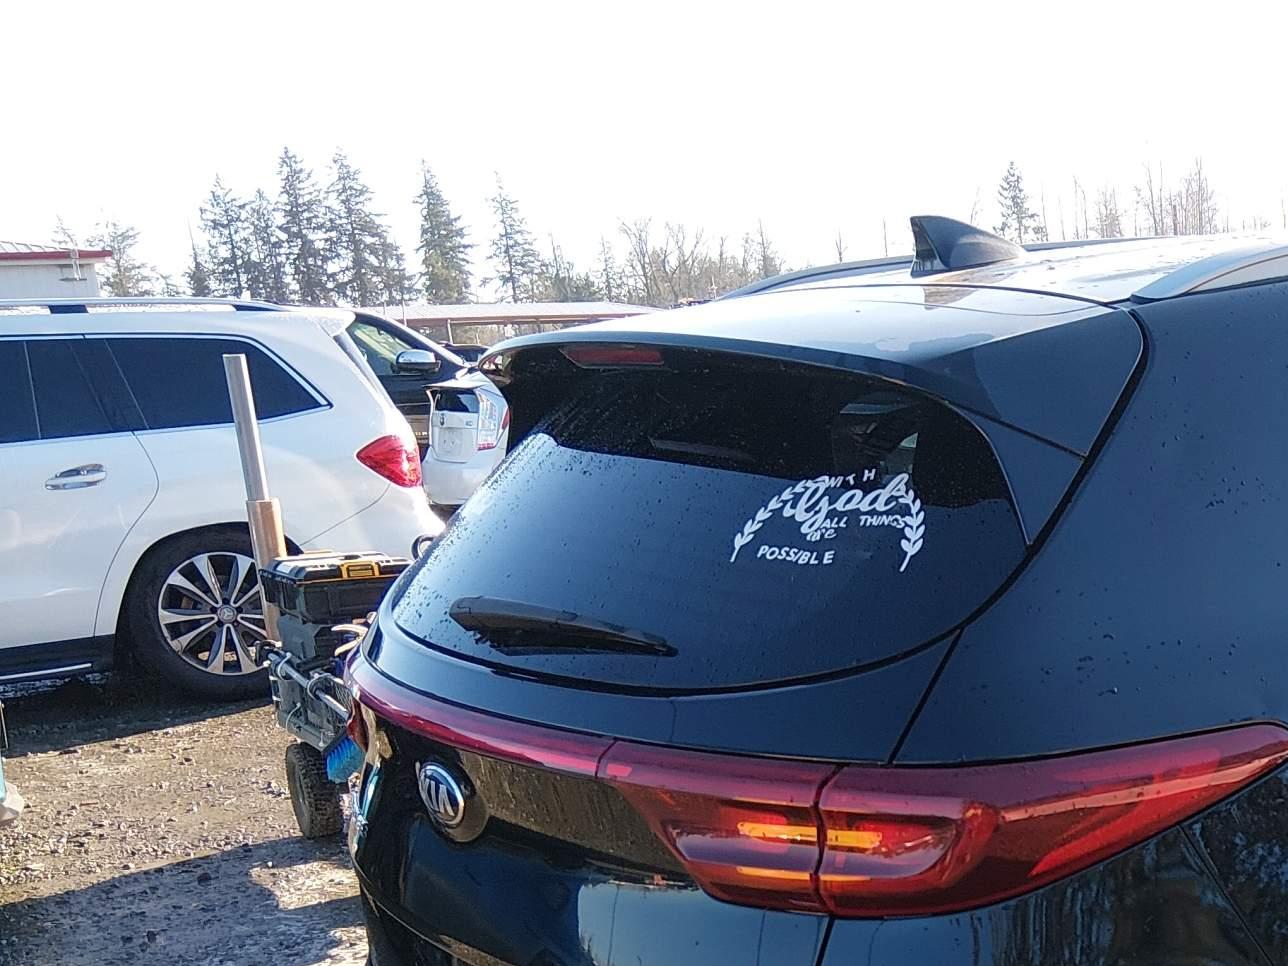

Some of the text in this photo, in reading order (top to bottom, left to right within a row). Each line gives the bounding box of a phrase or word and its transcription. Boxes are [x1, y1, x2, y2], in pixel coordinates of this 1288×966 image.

[821, 514, 905, 529] ALL THINGS
[757, 545, 835, 564] POSSIBLE
